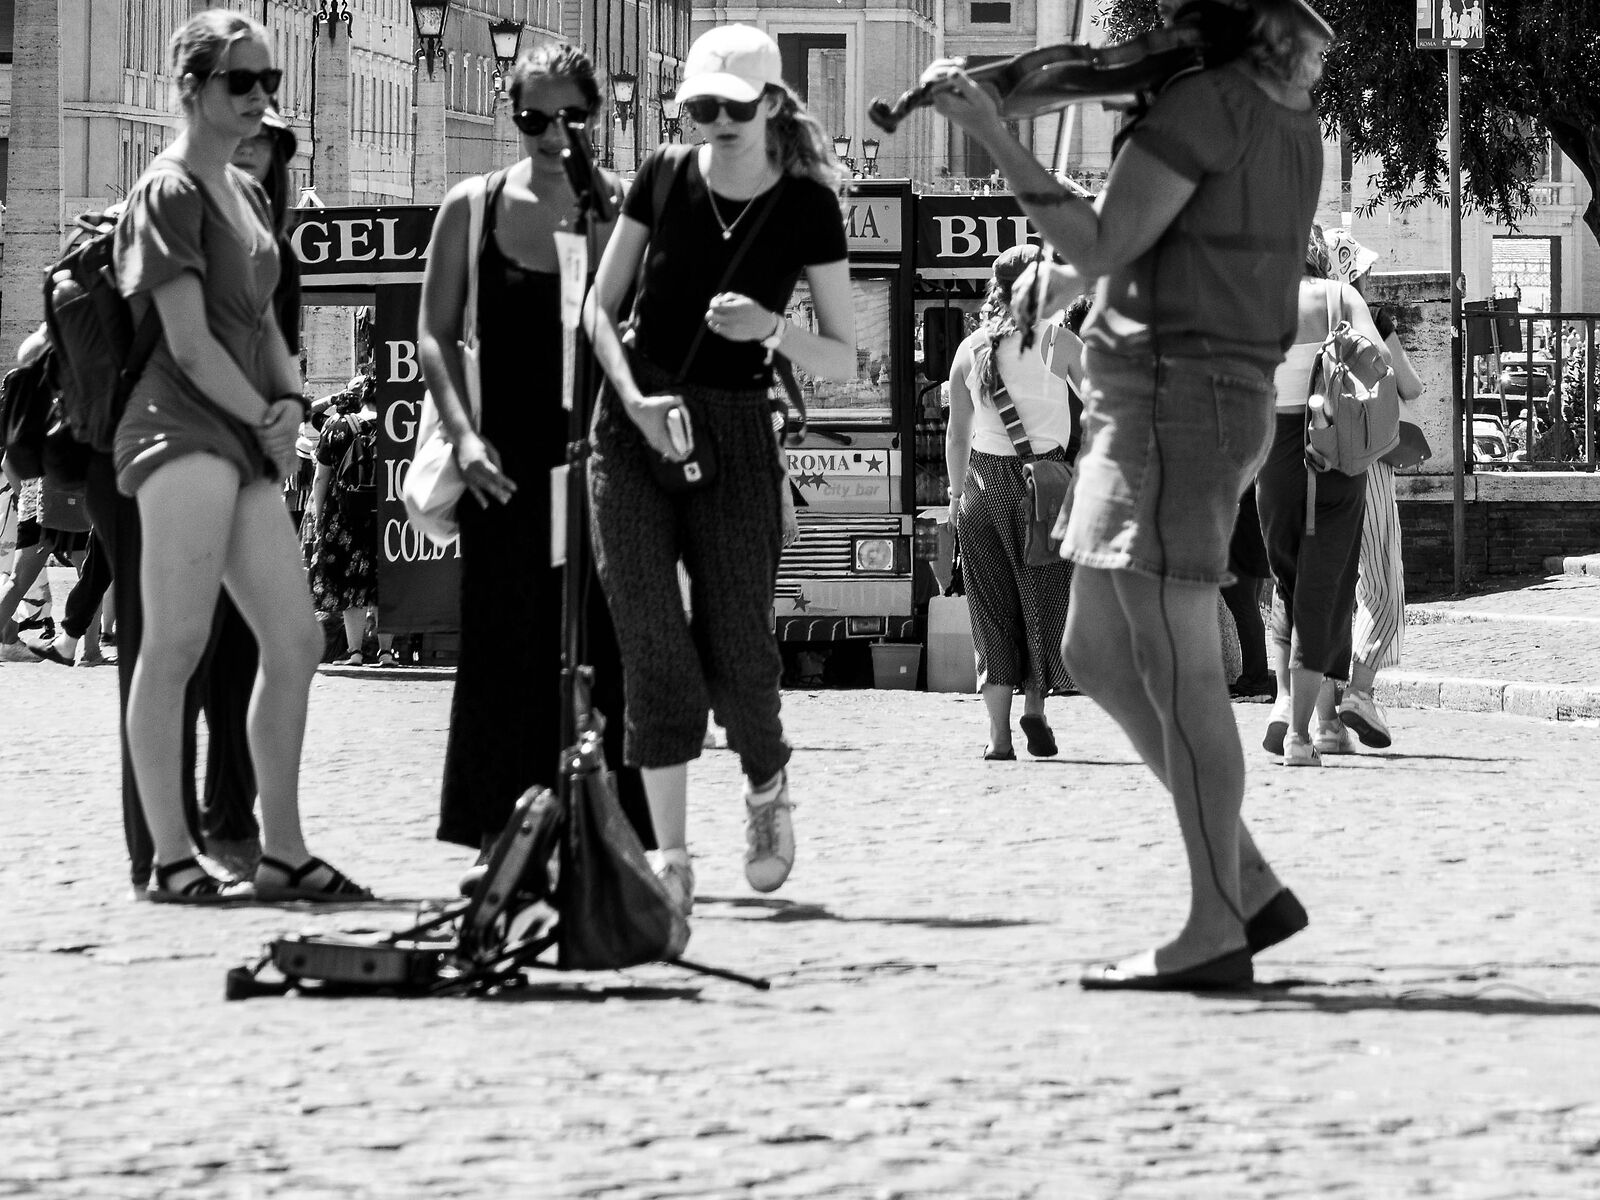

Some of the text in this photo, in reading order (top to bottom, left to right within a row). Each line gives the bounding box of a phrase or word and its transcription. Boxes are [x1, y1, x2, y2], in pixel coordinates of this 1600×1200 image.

[786, 453, 850, 471] ROMA
[823, 482, 881, 498] city bar
